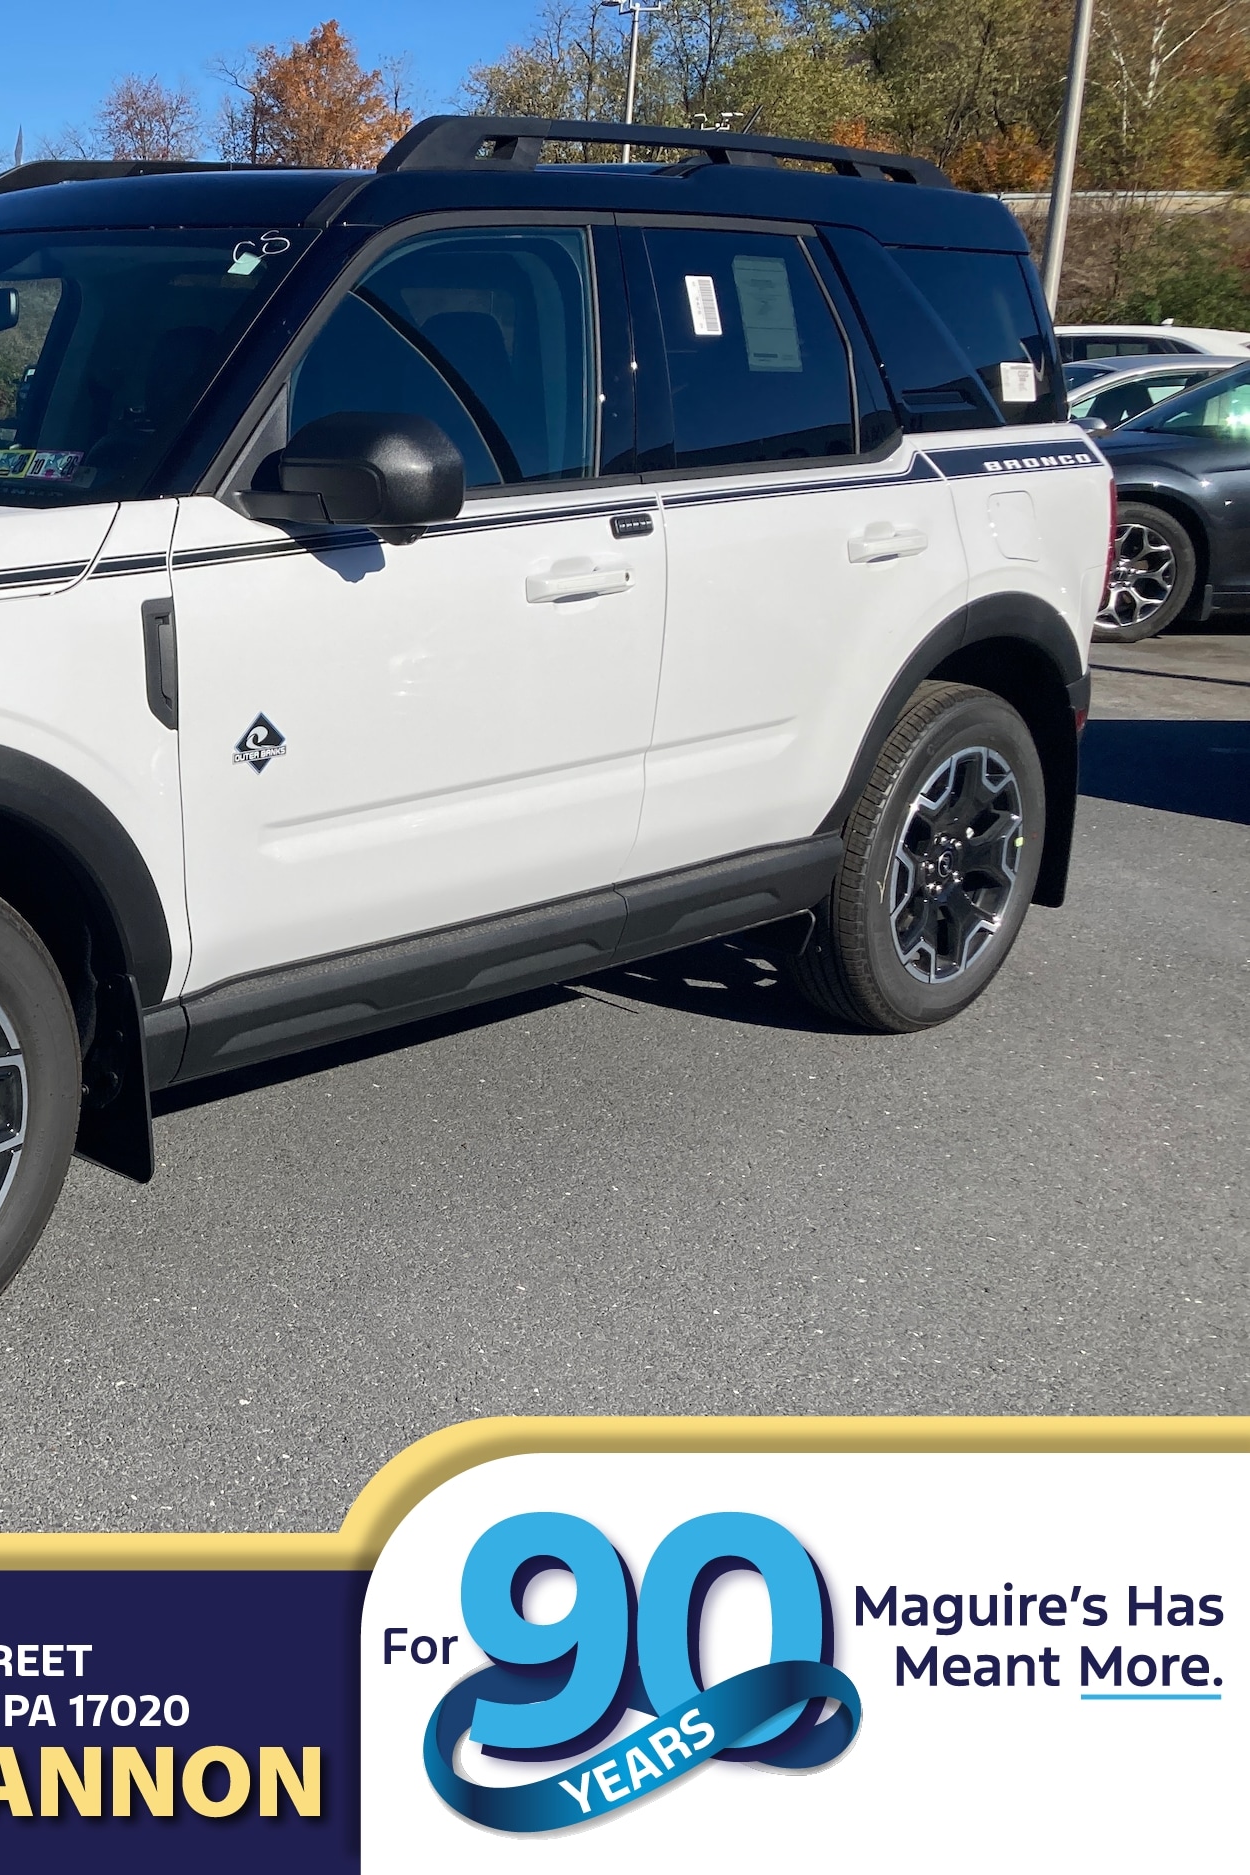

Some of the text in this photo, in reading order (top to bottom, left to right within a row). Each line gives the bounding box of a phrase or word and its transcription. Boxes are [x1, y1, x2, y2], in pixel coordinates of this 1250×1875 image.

[983, 453, 1092, 472] BRONCO
[235, 746, 286, 762] OUTER BANKS
